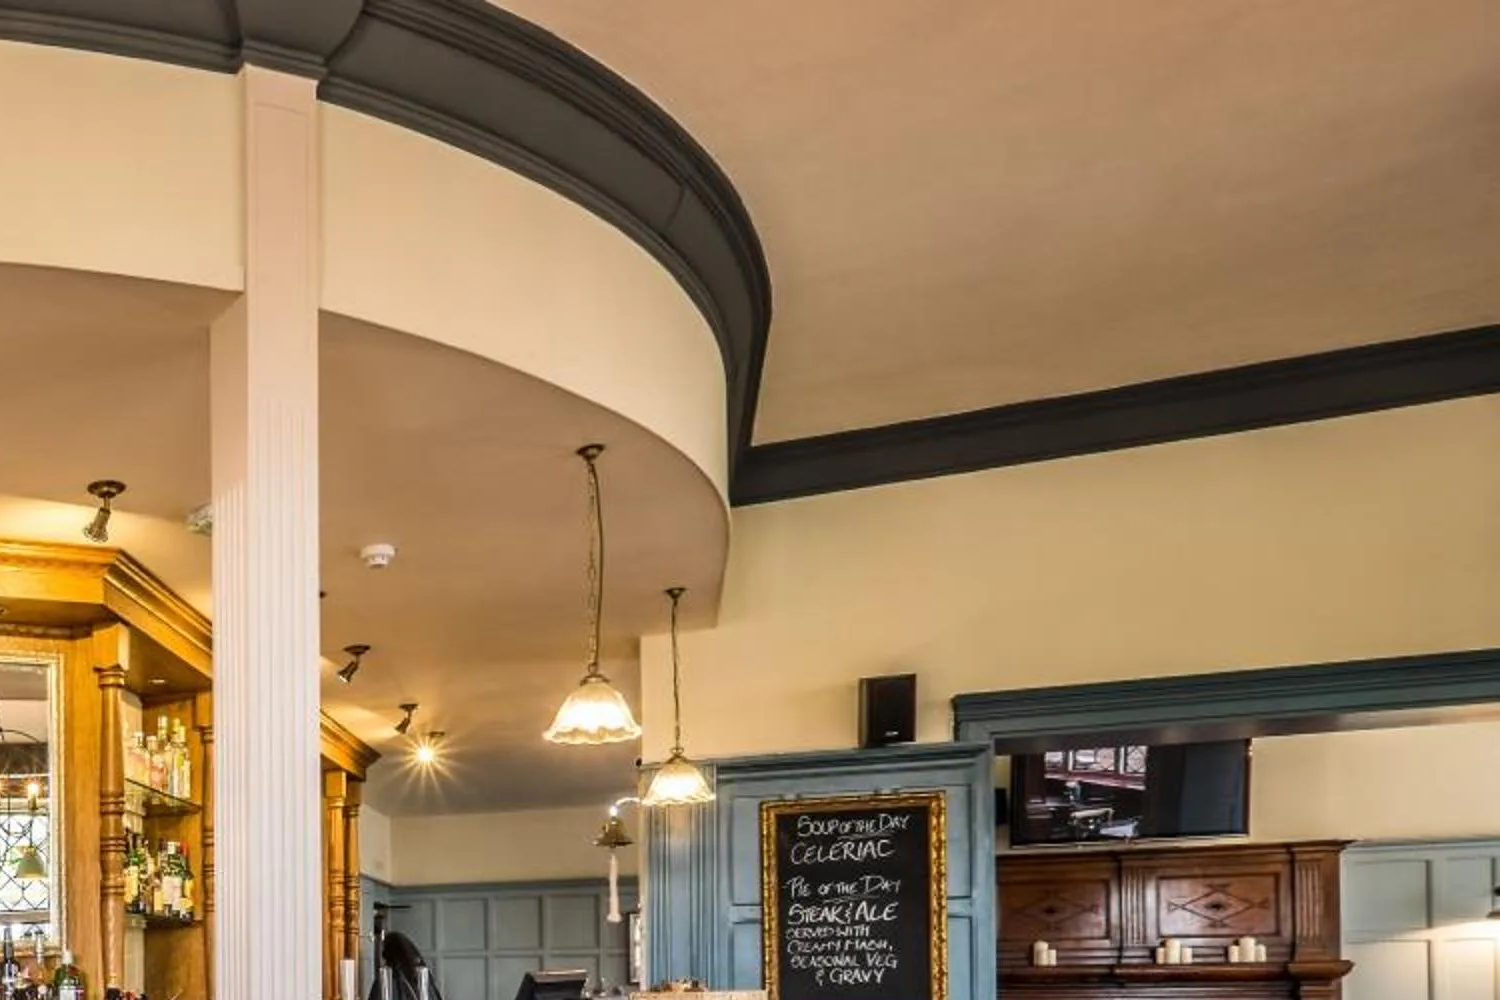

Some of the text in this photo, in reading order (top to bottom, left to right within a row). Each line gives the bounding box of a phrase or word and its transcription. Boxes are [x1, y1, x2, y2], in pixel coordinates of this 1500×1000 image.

[791, 839, 896, 864] CELERIAC
[788, 903, 844, 925] STEAK
[854, 900, 899, 922] ALE
[829, 967, 885, 985] GRAVY
